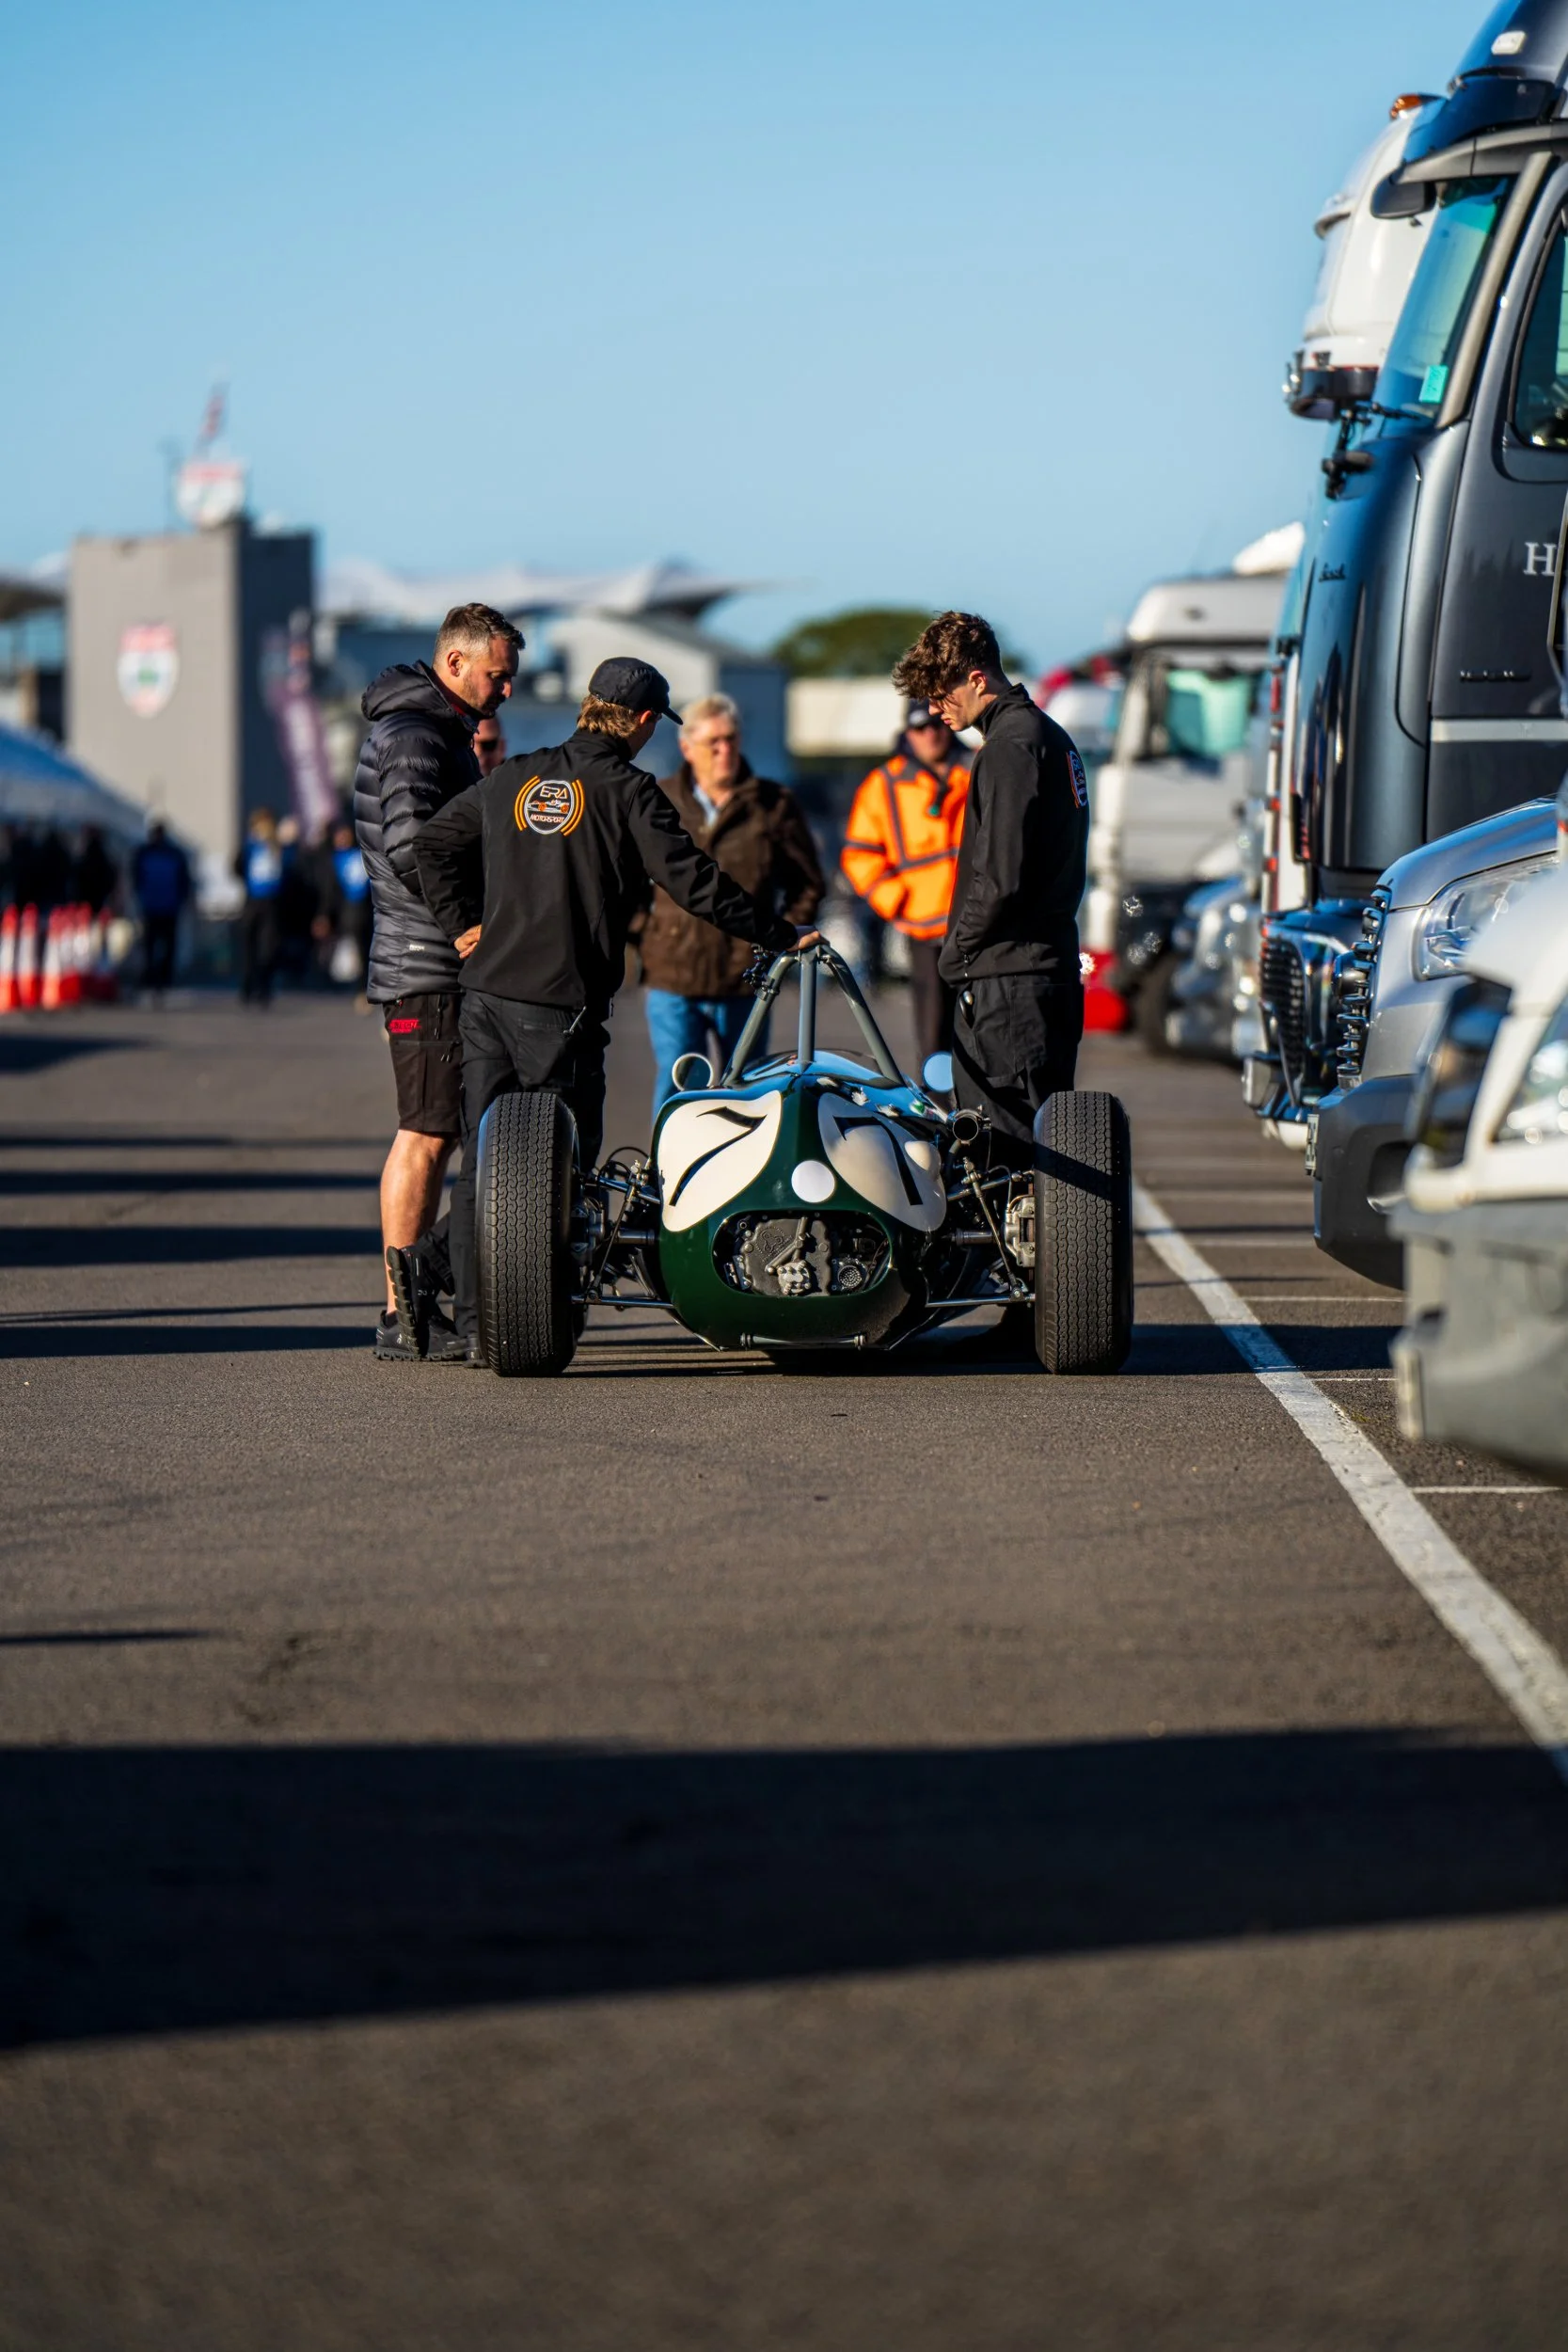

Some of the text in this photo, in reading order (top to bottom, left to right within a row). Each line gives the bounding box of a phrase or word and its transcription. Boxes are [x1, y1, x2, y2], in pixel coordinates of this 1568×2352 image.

[540, 786, 568, 799] ERA
[529, 814, 565, 823] MOTORSPORT
[669, 1106, 768, 1207] 7
[832, 1116, 924, 1206] 7
